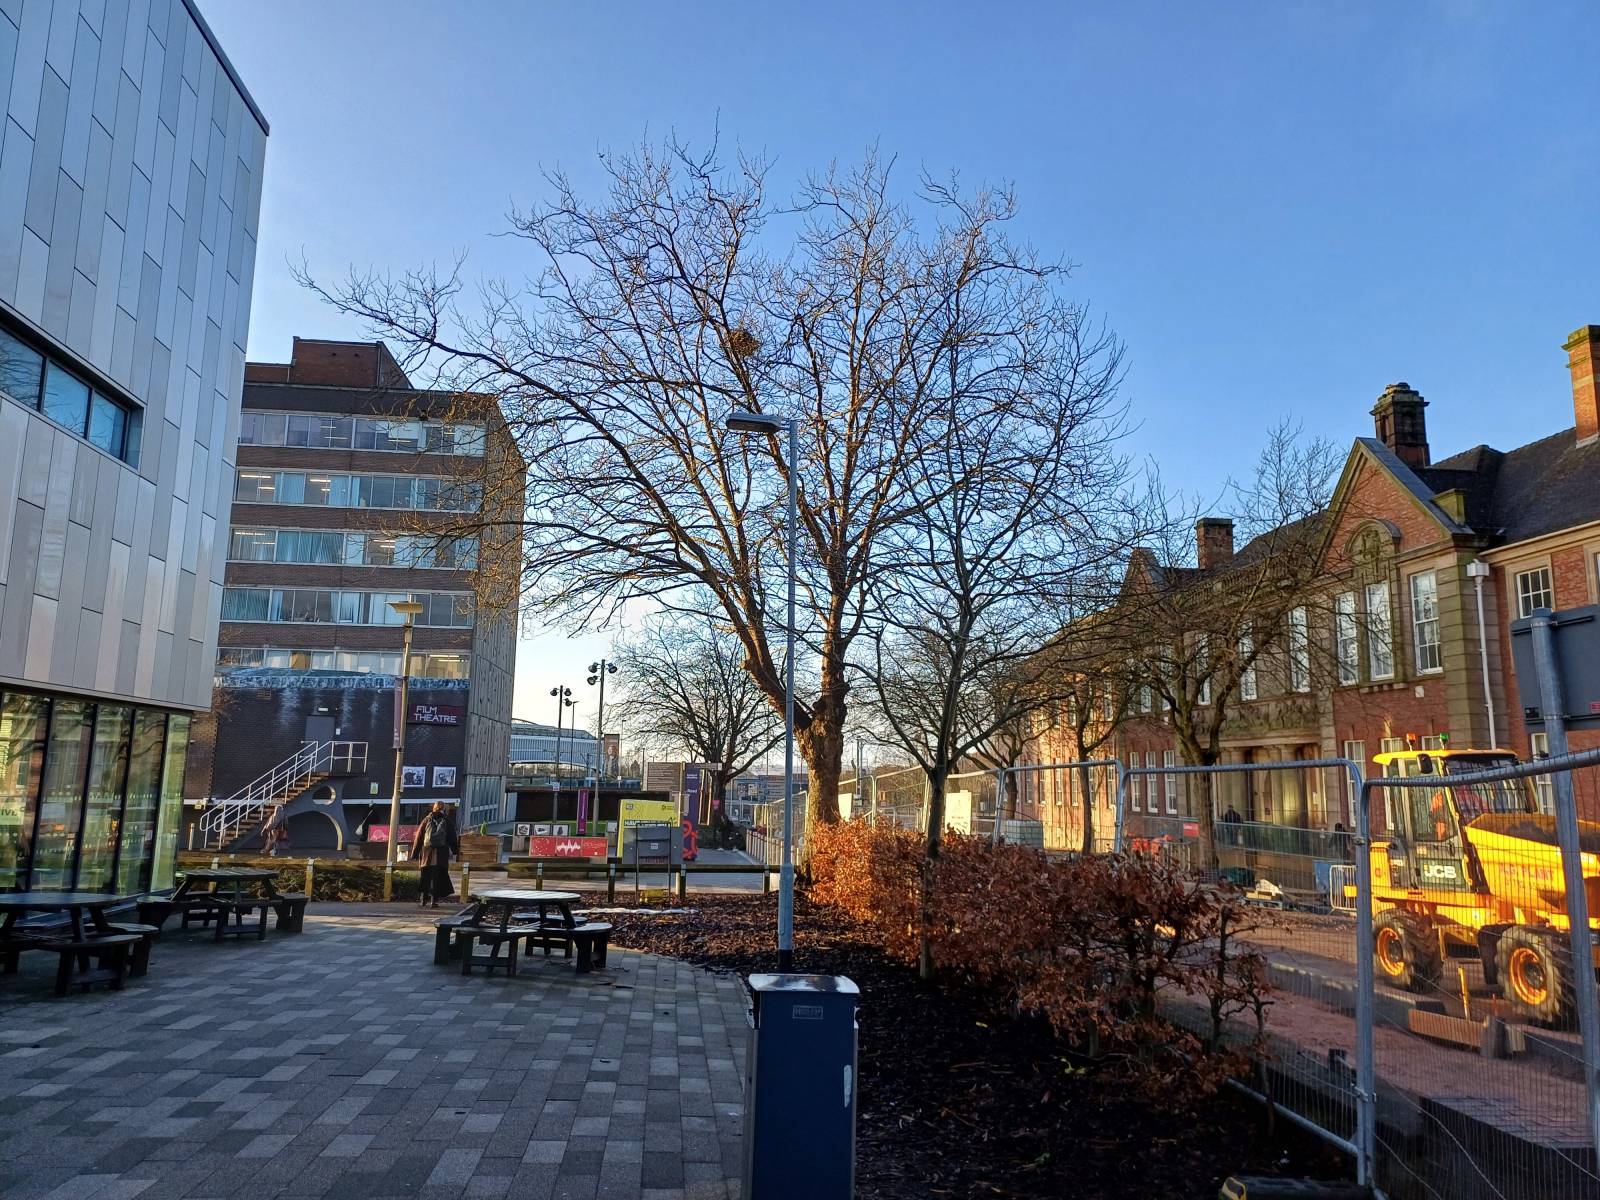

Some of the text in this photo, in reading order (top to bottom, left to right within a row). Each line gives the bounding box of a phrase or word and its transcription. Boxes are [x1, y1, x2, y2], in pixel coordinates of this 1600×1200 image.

[416, 705, 438, 714] FILM
[414, 713, 457, 723] THEATRE
[1424, 864, 1457, 879] JCB
